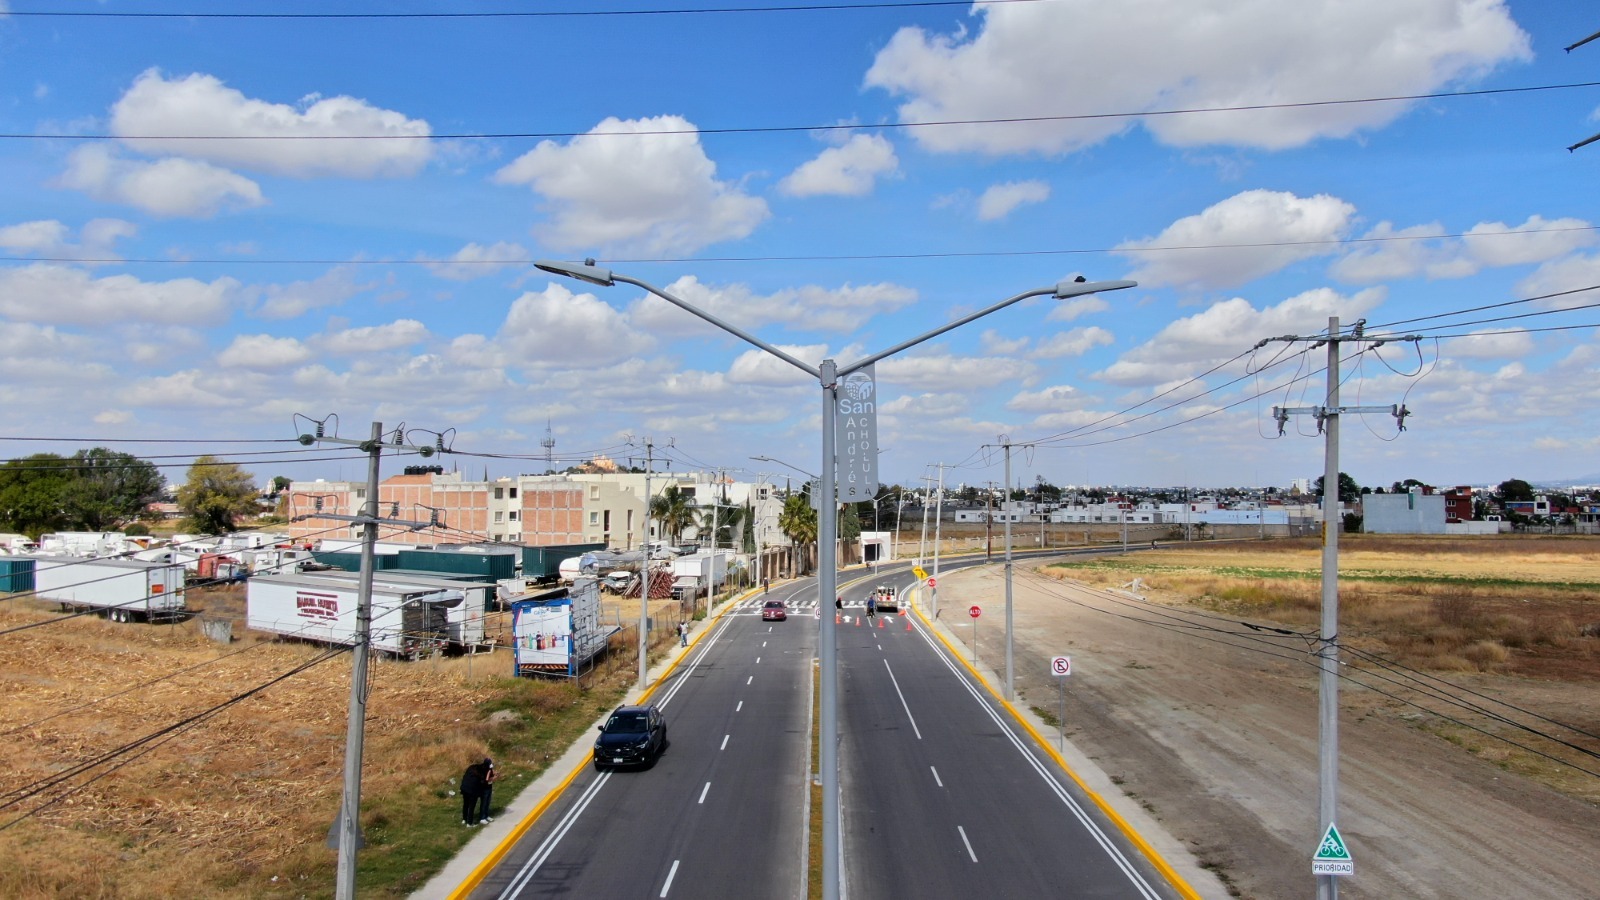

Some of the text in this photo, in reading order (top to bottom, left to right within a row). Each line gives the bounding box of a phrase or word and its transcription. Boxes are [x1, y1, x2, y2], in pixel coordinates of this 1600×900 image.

[840, 398, 873, 414] San
[860, 418, 872, 496] CHOLULA
[1314, 864, 1351, 873] PRIORIDAD
